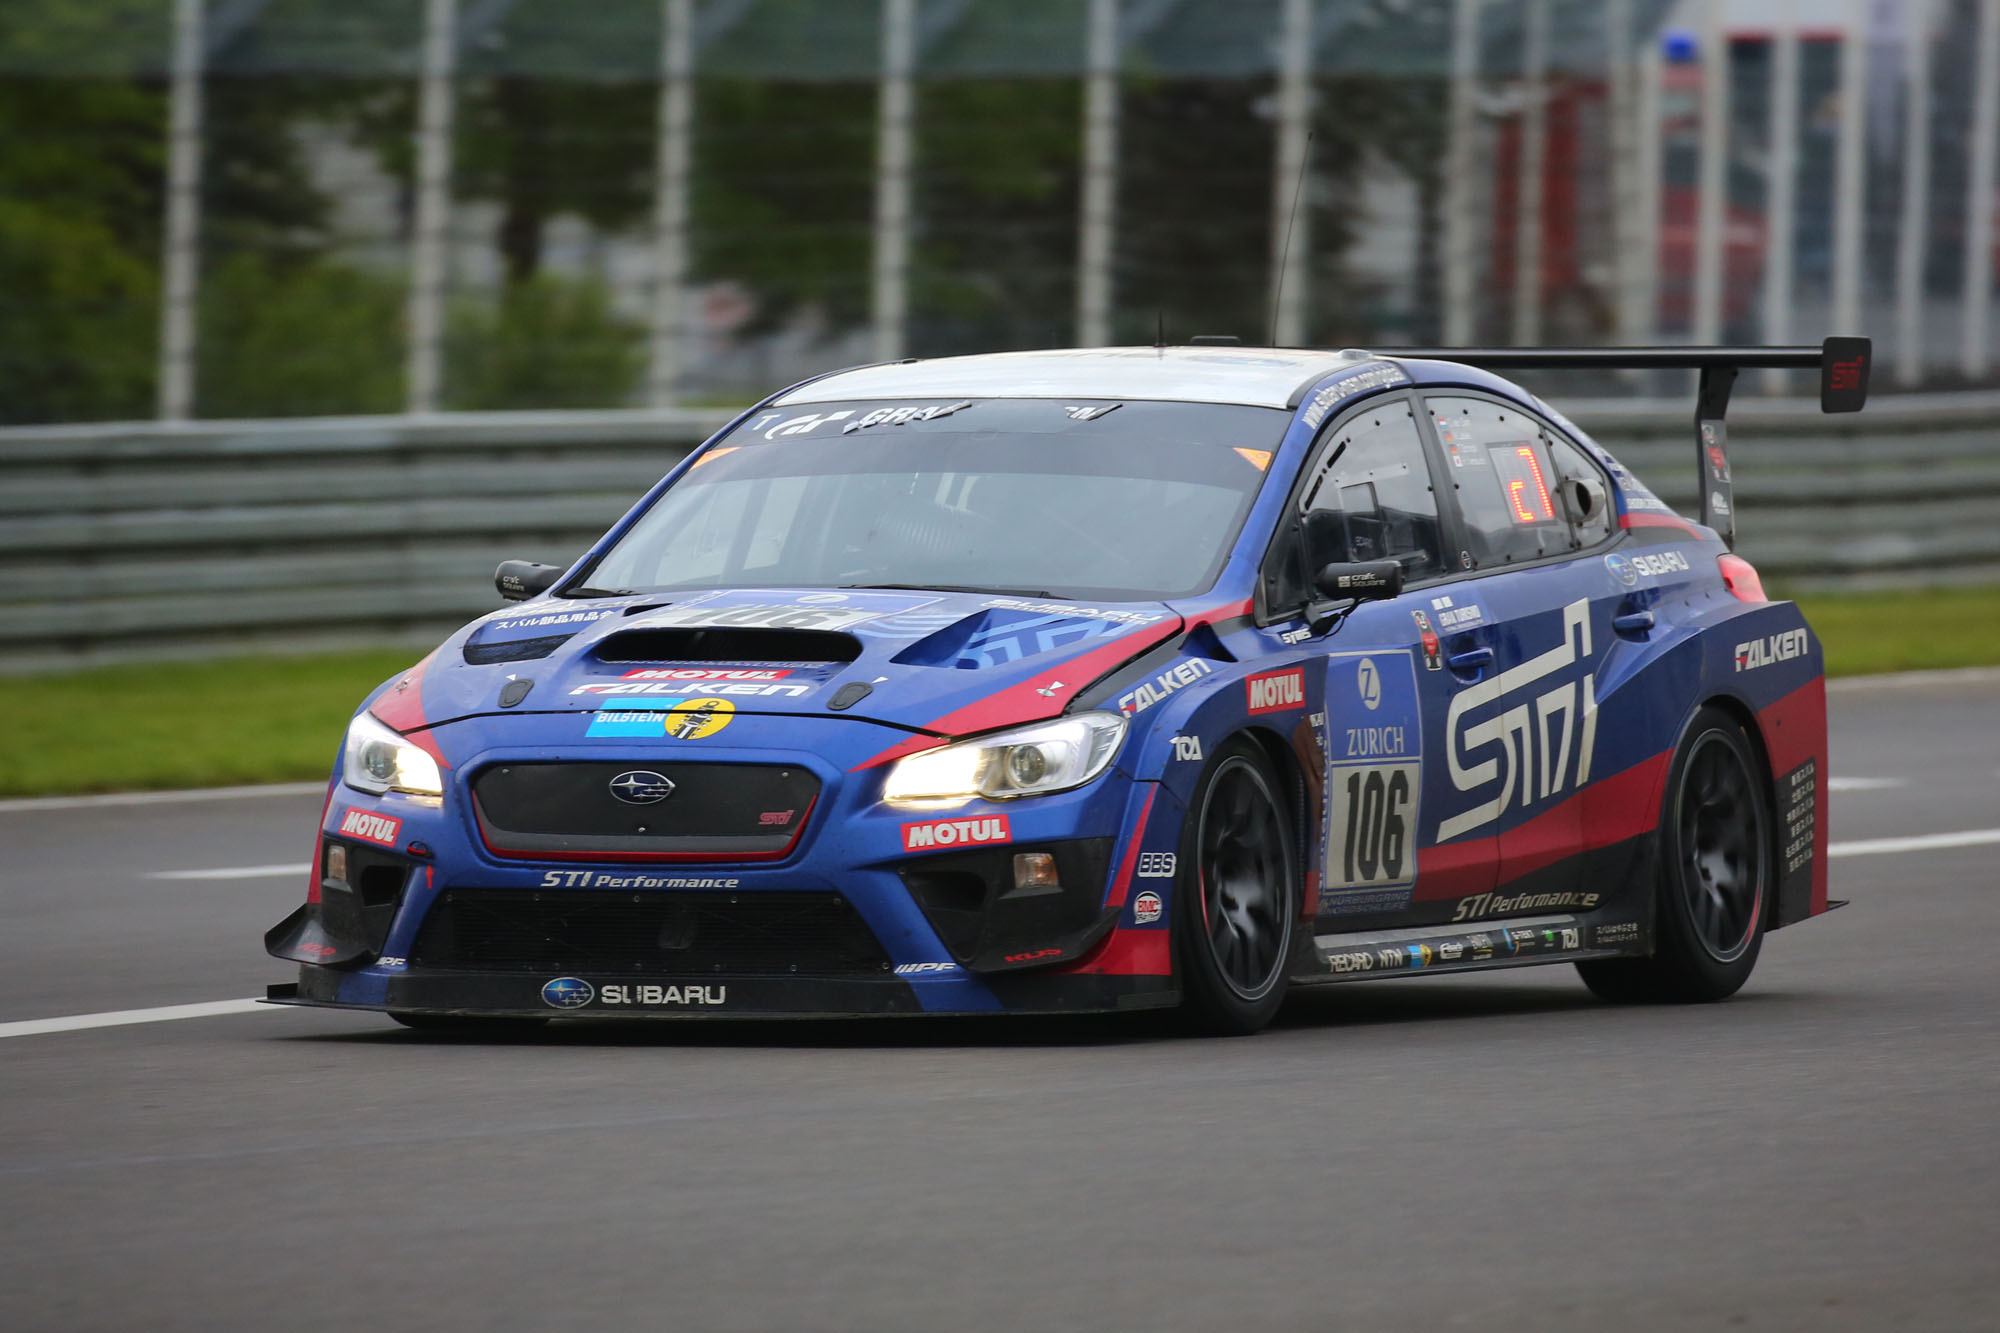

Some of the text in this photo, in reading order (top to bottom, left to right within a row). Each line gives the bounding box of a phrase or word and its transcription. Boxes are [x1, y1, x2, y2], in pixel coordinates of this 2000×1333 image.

[1632, 551, 1690, 576] SUBARU
[1735, 628, 1808, 672] FALKEN
[626, 669, 780, 680] MOTUL
[1118, 657, 1212, 718] FALKEN
[569, 683, 810, 696] FALKEN
[1250, 674, 1303, 709] MOTUL
[1346, 727, 1405, 756] ZURICH
[341, 811, 397, 842] MOTUL
[908, 819, 1006, 847] MOTUL
[1344, 770, 1409, 882] 106
[1138, 853, 1176, 877] BBS
[541, 871, 740, 888] STI Performance
[1137, 900, 1160, 913] BMC
[1451, 892, 1600, 921] STI Performance
[1328, 952, 1374, 973] RECARO
[1377, 949, 1403, 968] NTN
[601, 985, 726, 1004] SUBARU
